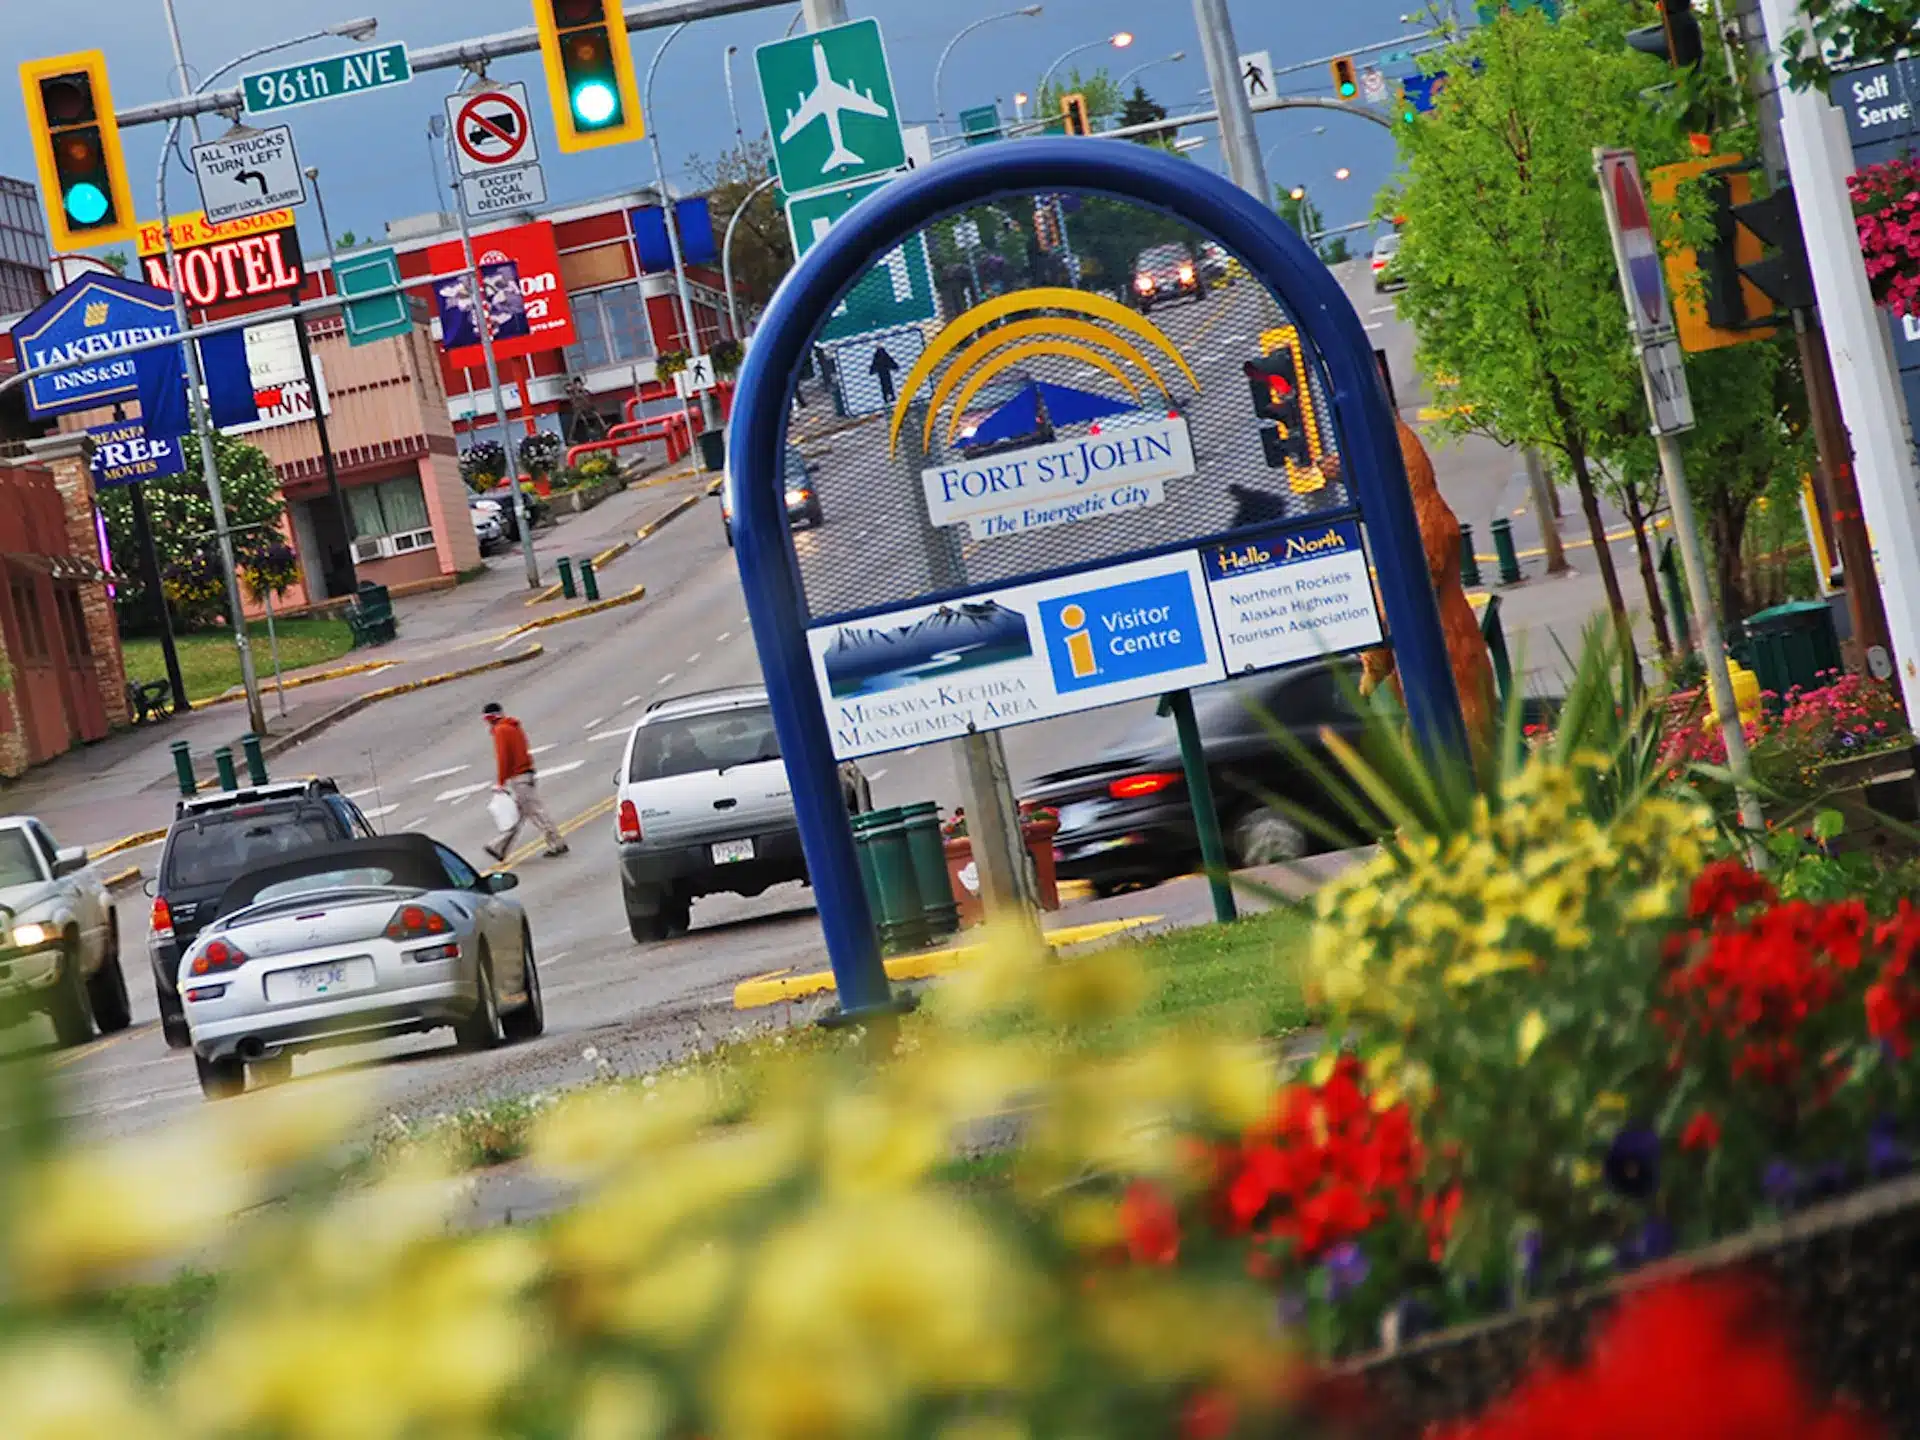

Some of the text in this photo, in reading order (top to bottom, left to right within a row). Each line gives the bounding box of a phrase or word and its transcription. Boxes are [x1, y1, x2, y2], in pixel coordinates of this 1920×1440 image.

[256, 51, 396, 106] 96th AVE
[1853, 74, 1889, 103] Self
[1857, 102, 1910, 128] Serve
[199, 134, 285, 164] ALL TRUCKS
[206, 148, 284, 176] TURN LEFT
[479, 171, 524, 189] EXCEPT
[484, 184, 522, 198] LOCAL
[209, 203, 237, 218] EXCEPT
[477, 191, 534, 210] DELIVERY
[145, 233, 299, 307] MOTEL
[34, 325, 172, 376] LAKEVIEW
[103, 460, 158, 481] MOVIES
[938, 460, 1028, 503] FORT
[1074, 432, 1172, 485] JOHN
[980, 484, 1151, 536] The Energetic City
[1217, 544, 1271, 571] Hello
[1285, 528, 1345, 560] North
[1229, 571, 1352, 607] Northern Rockies
[1101, 605, 1170, 632] Visitor
[1240, 591, 1350, 624] Alaska Highway
[1228, 624, 1286, 646] Tourism
[1289, 606, 1370, 632] Association
[1109, 628, 1181, 656] Centre
[839, 677, 1027, 728] MUSKWA-KECHIKA
[836, 697, 1039, 750] MANAGEMENT AREA
